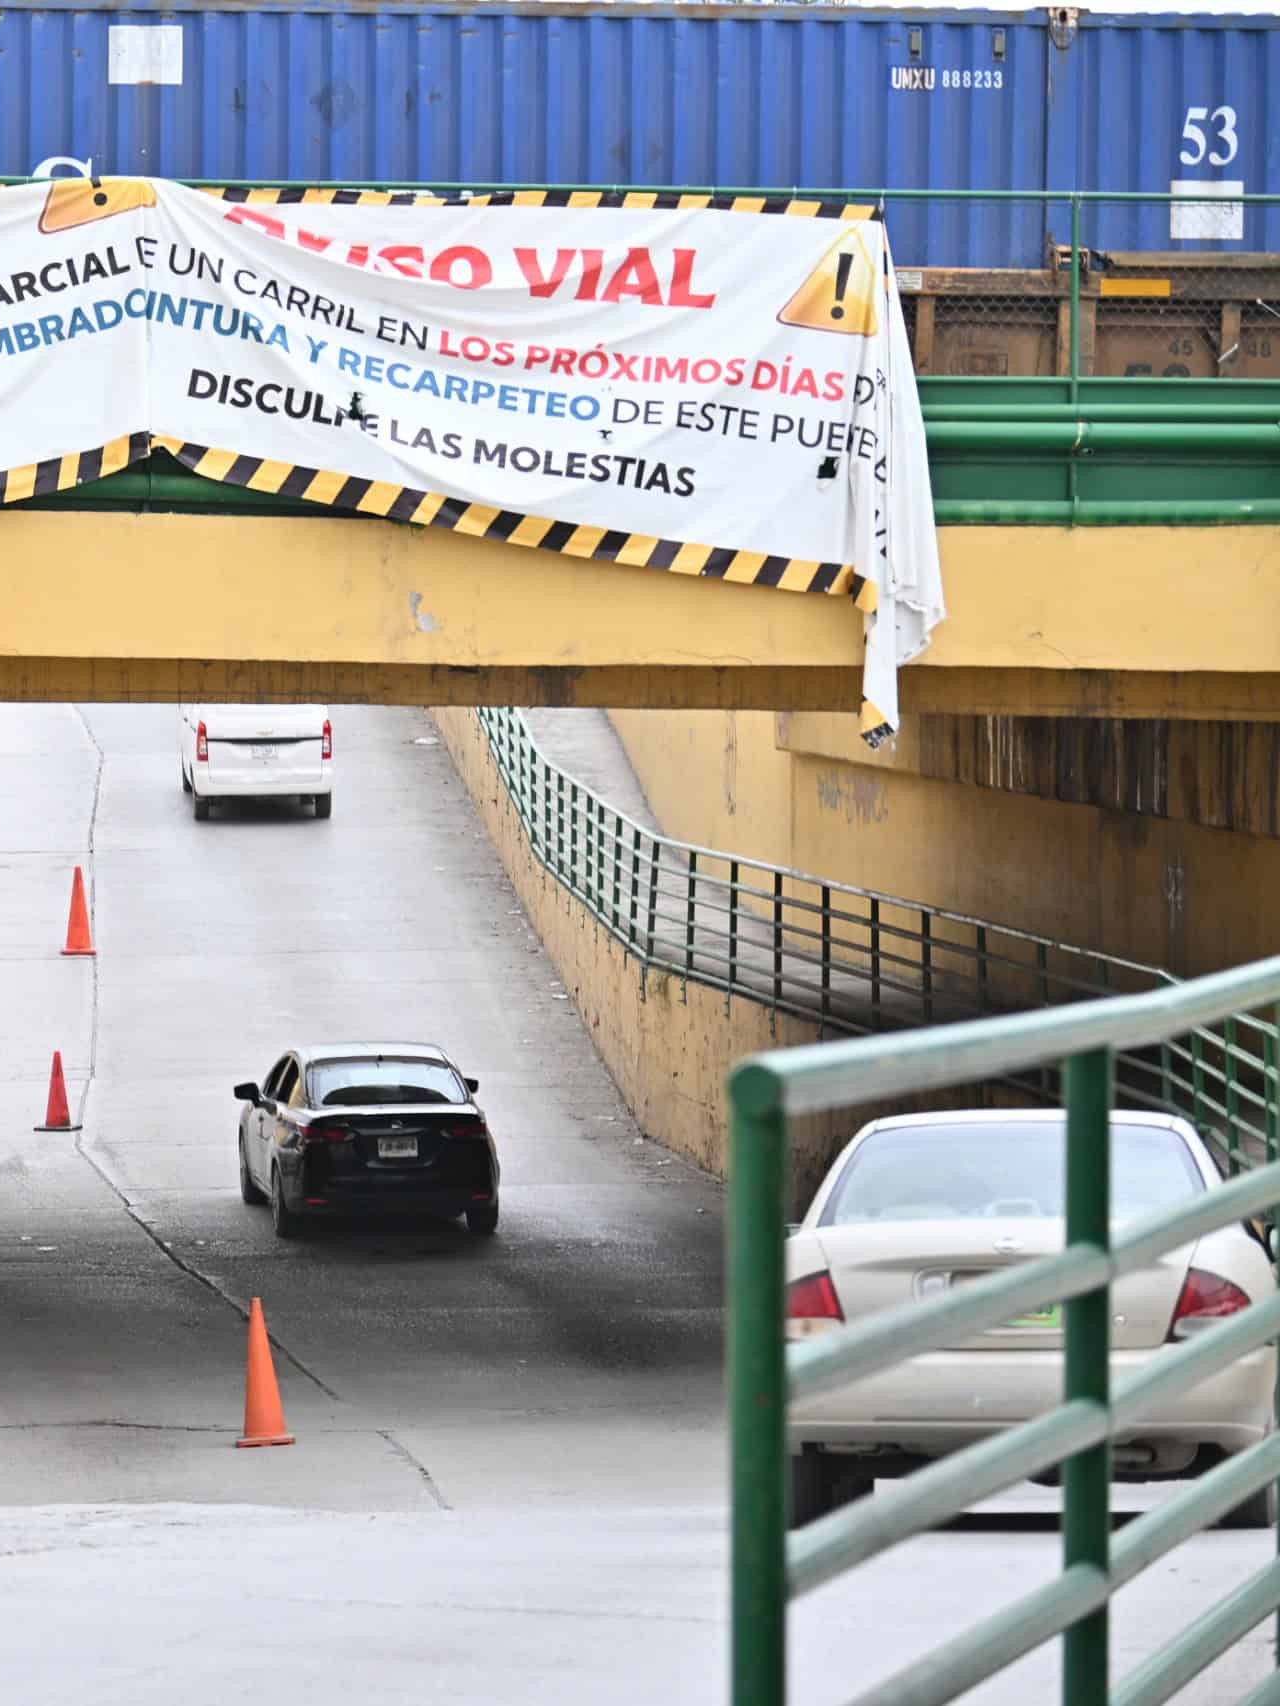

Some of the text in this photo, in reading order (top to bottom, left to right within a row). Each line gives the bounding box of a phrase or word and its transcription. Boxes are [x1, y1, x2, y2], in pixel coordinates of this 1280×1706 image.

[941, 69, 1004, 89] 888233
[1179, 105, 1239, 167] 53
[513, 247, 718, 310] VIAL
[169, 243, 225, 284] UN
[233, 268, 365, 334] CARRIL
[376, 315, 429, 351] EN
[438, 330, 515, 367] LOS
[523, 343, 747, 386] PRÓXIMOS
[750, 356, 845, 403] DÍAS
[145, 289, 291, 354] INTURA
[306, 334, 329, 365] Y
[338, 346, 601, 422] RECARPETEO
[612, 398, 665, 425] DE
[675, 400, 760, 440] ESTE
[390, 419, 463, 461] LAS
[472, 437, 697, 498] MOLESTIAS
